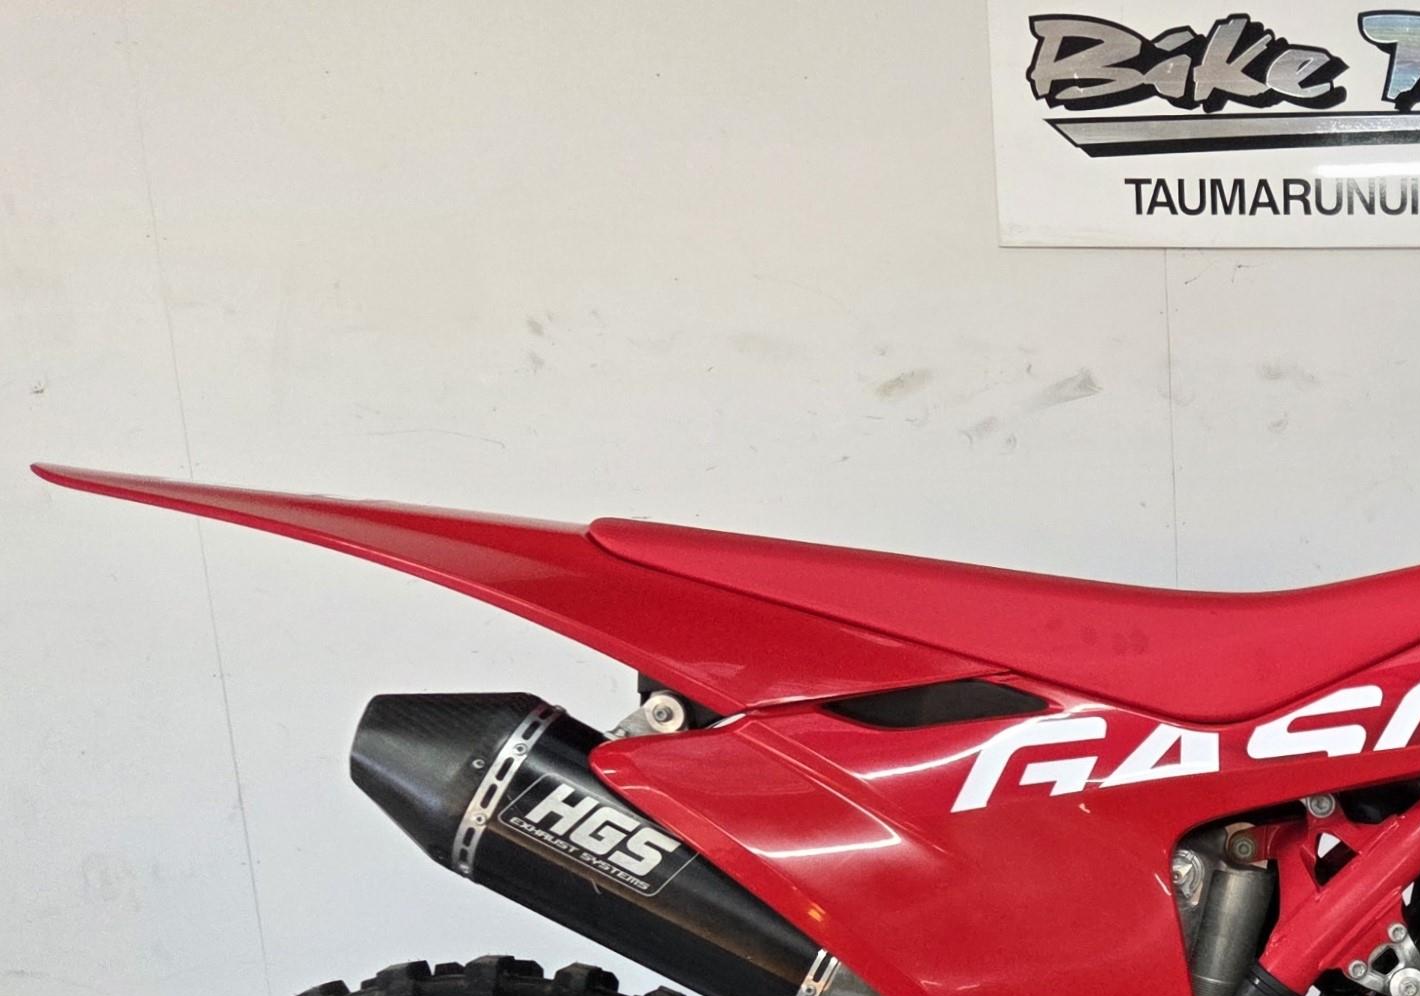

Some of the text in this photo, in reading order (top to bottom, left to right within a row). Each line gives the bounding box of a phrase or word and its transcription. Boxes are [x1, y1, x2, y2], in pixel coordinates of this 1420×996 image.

[1028, 13, 1350, 112] Bike
[509, 815, 652, 892] EXHAUST SYSTEMS
[524, 782, 683, 878] HGS
